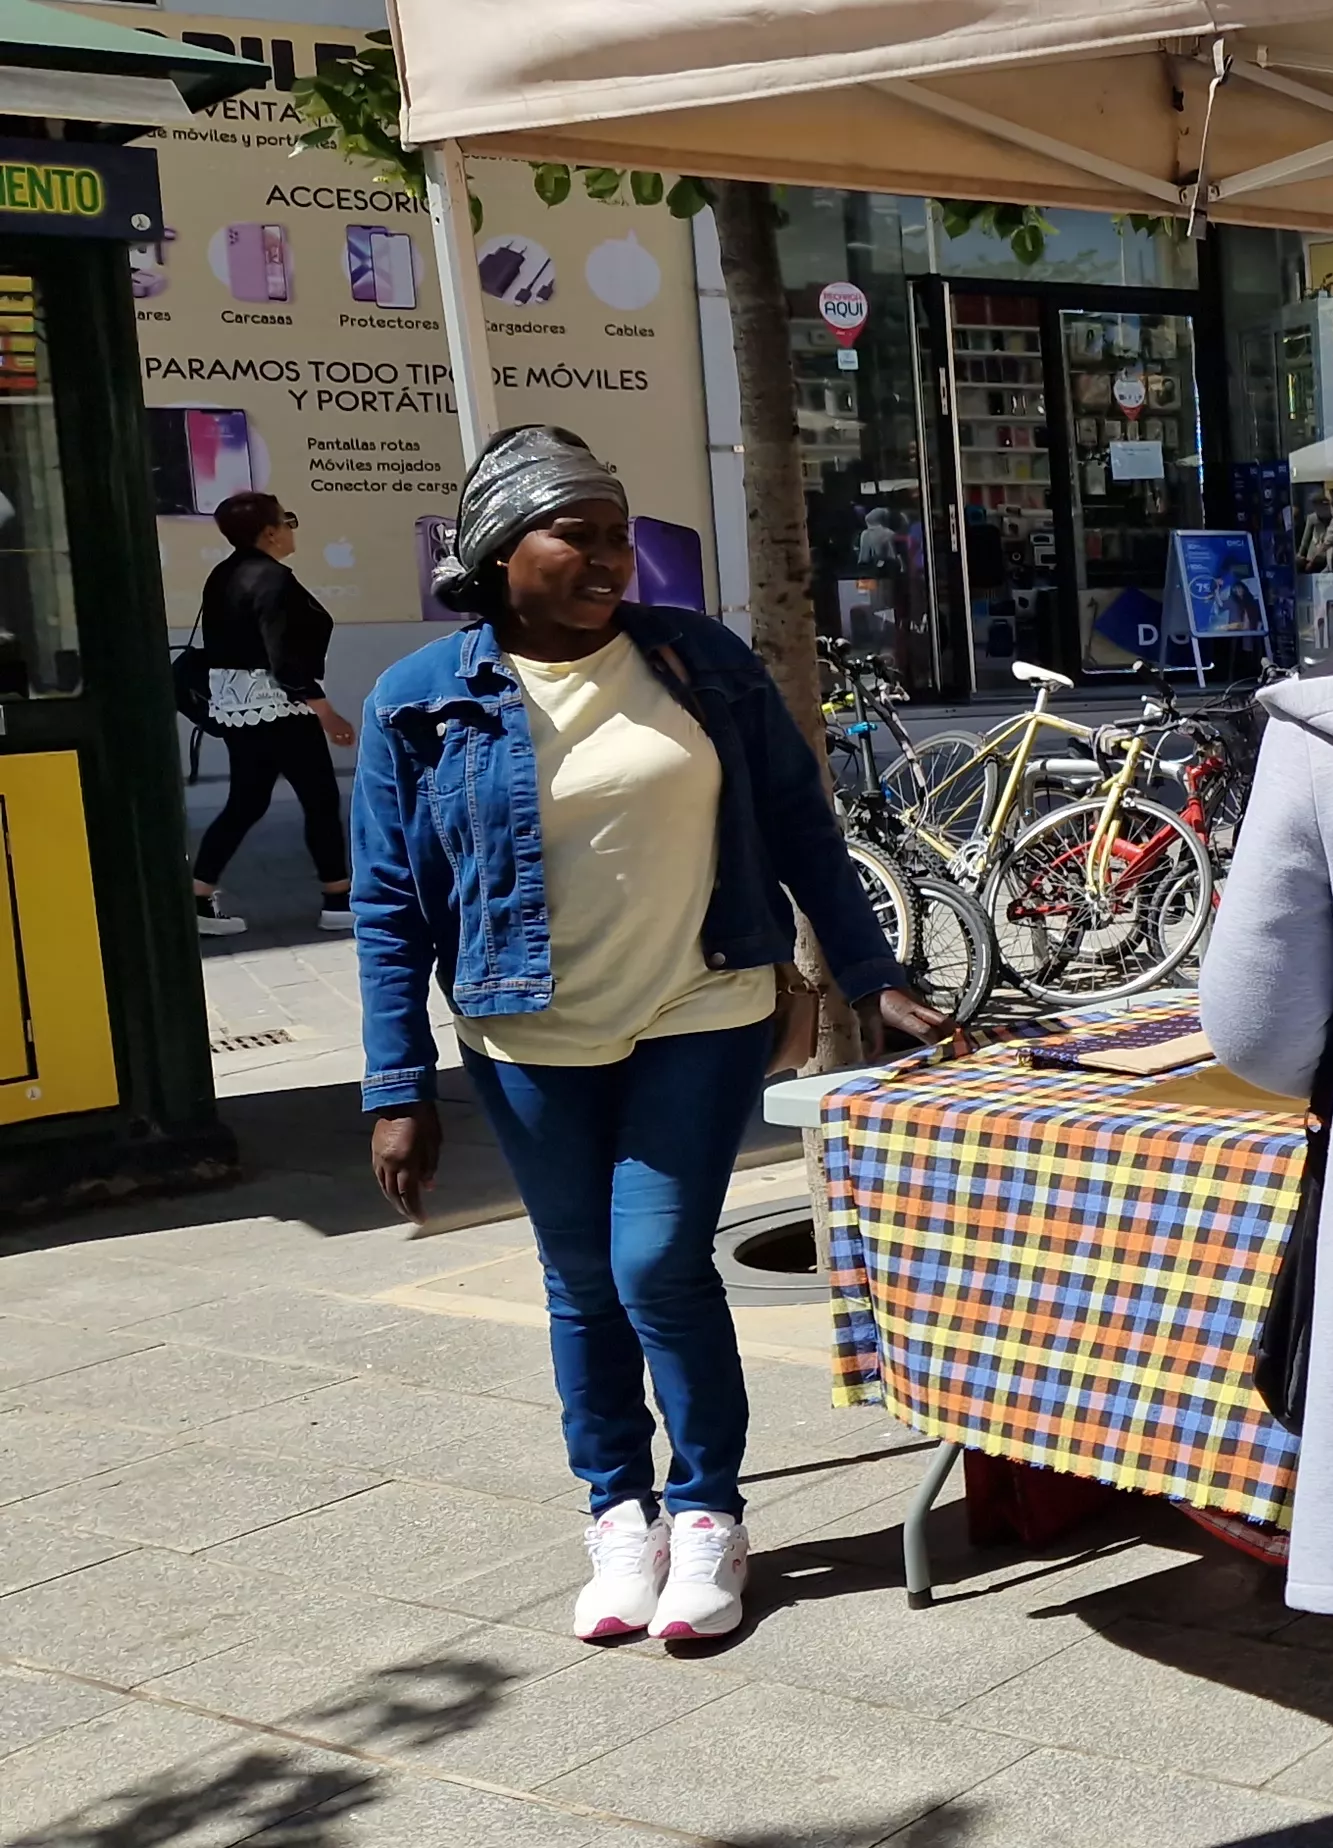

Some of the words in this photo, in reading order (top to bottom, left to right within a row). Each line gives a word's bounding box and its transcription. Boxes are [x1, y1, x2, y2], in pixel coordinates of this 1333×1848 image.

[204, 99, 302, 123] VENTA
[173, 128, 237, 143] móviles
[242, 134, 251, 148] y
[266, 184, 431, 214] ACCESORI
[221, 310, 293, 325] Carcasas
[339, 314, 440, 330] Protectores
[604, 323, 655, 337] Cables
[145, 357, 301, 383] PARAMOS
[308, 360, 398, 385] TODO
[406, 363, 454, 385] TIP
[526, 362, 649, 390] MÓVILES
[288, 389, 308, 411] Y
[317, 386, 458, 414] PORTÁTIL
[307, 437, 376, 451] Pantallas
[380, 438, 421, 452] rotas
[309, 458, 372, 472] Móviles
[377, 458, 441, 475] mojados
[311, 478, 388, 492] Conector
[392, 479, 413, 492] de
[417, 481, 458, 495] carga
